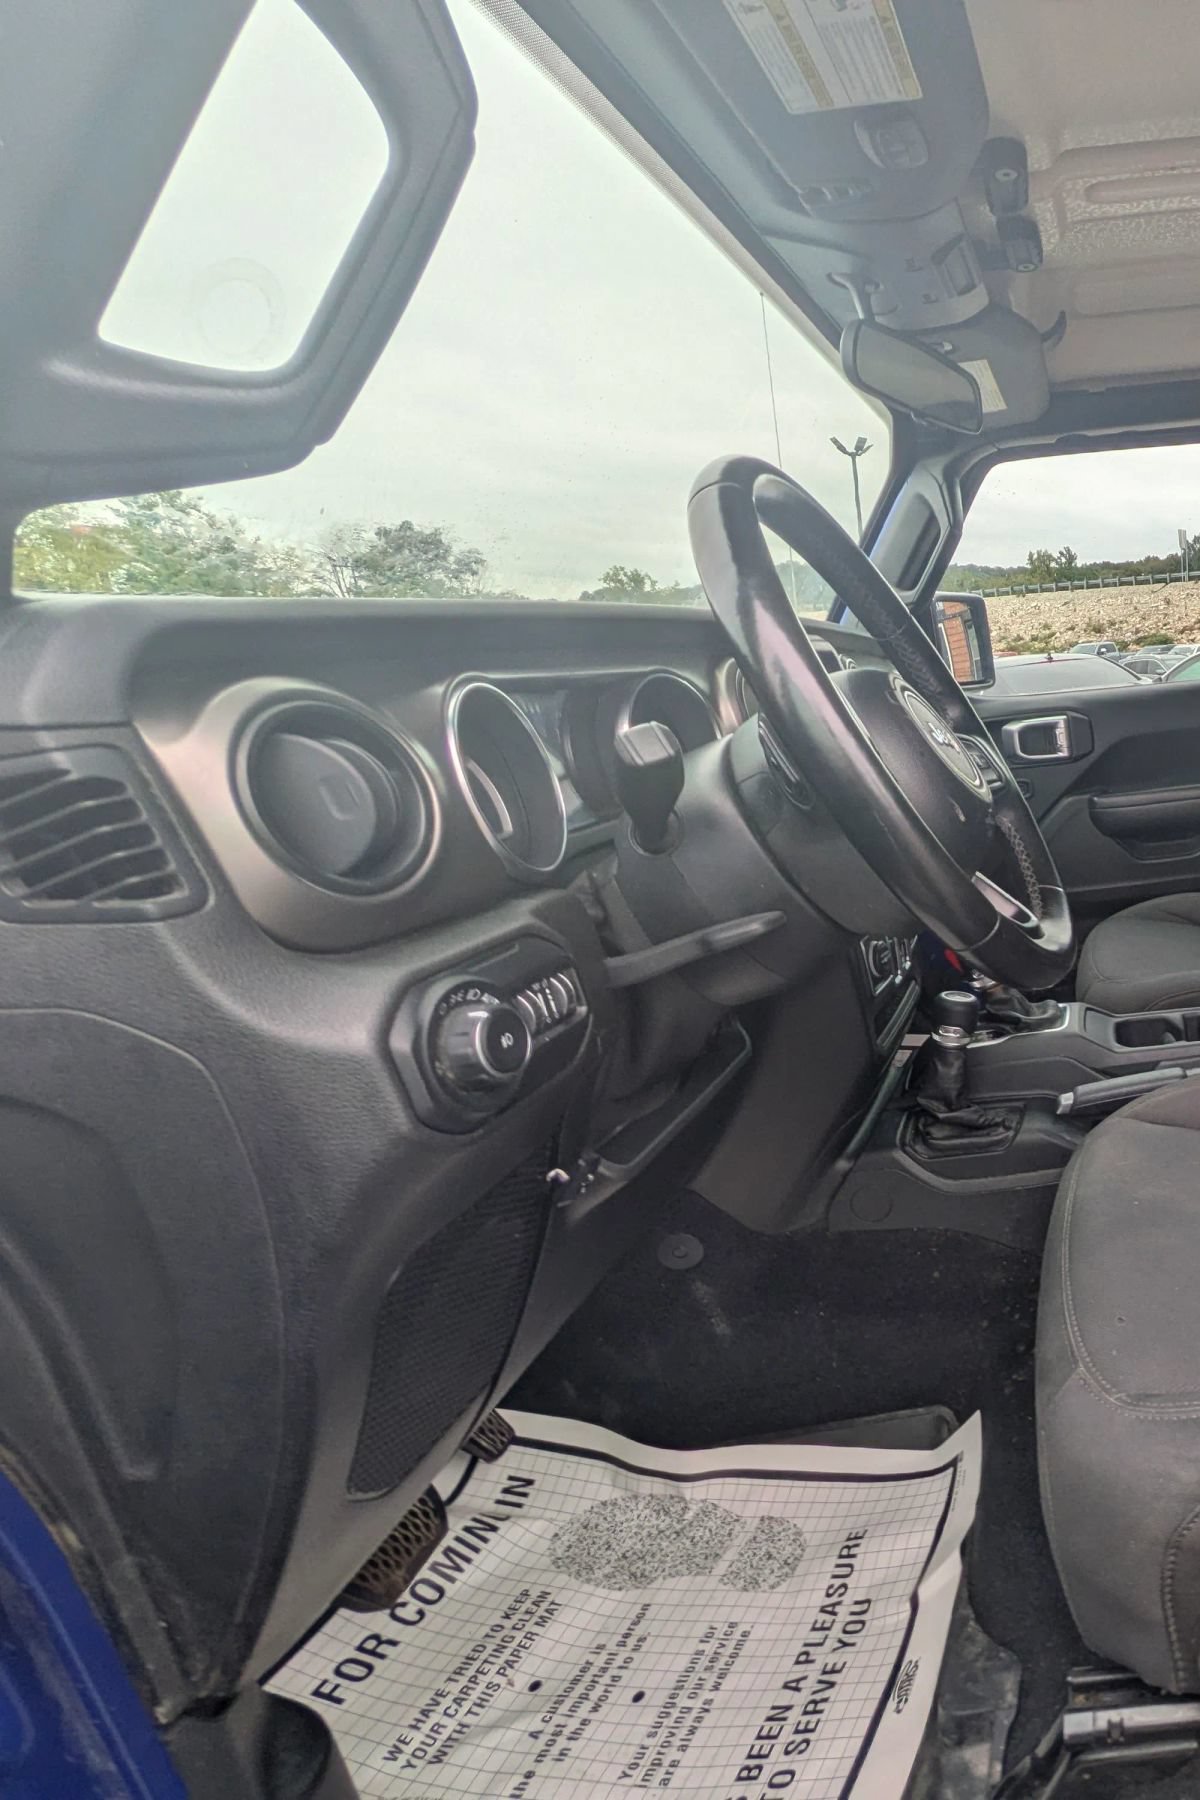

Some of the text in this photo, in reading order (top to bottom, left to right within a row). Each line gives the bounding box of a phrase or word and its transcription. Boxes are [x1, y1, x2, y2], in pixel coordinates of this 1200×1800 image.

[311, 1633, 399, 1705] FOR
[494, 1475, 535, 1508] IN
[793, 1528, 869, 1667] PLEASURE
[383, 1588, 531, 1762] WE HAVE TRIED TO KEEP
[400, 1722, 448, 1772] YOUR
[443, 1634, 514, 1721] CARPETING
[512, 1591, 552, 1633] CLEAN
[427, 1600, 562, 1766] WITH THIS PAPER MAT
[509, 1603, 652, 1799] the most important person
[528, 1642, 607, 1741] A customer is
[552, 1631, 652, 1763] in the world to us.
[618, 1624, 718, 1781] Your suggestions for
[634, 1621, 738, 1789] improving our service
[659, 1624, 754, 1787] are always welcome.
[734, 1704, 795, 1782] BEEN
[782, 1674, 809, 1693] A
[783, 1661, 847, 1756] SERVE
[832, 1598, 872, 1653] YOU
